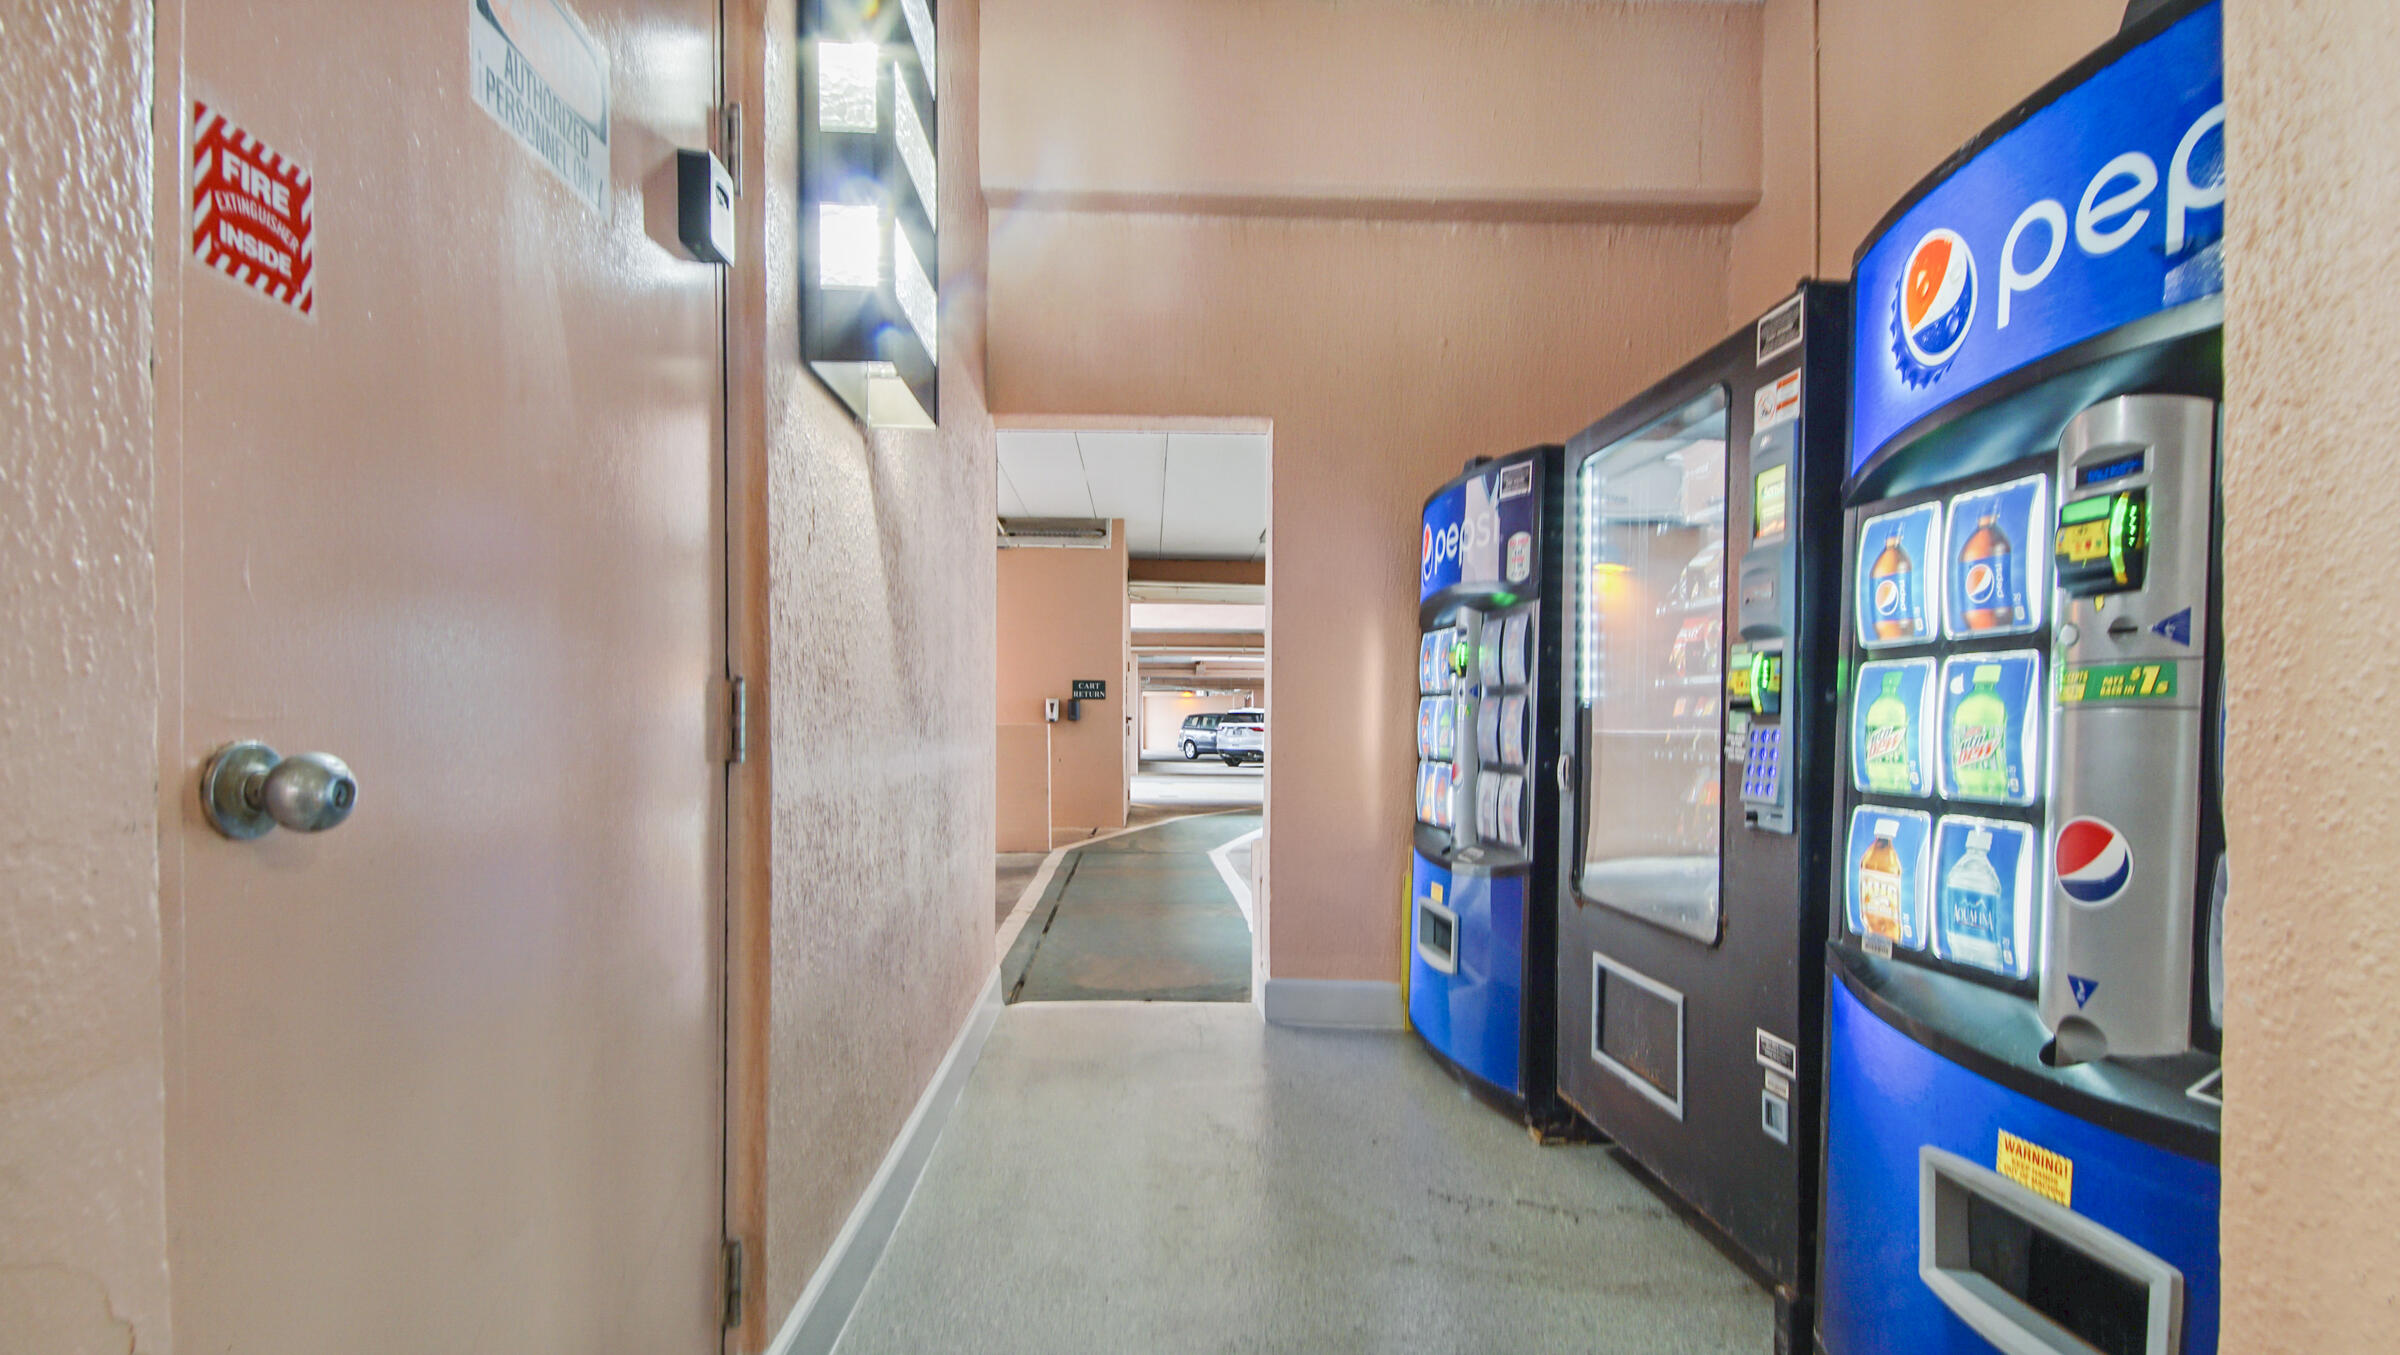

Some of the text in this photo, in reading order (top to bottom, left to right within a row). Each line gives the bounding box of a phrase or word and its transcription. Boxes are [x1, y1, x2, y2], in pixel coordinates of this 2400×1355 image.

[486, 65, 570, 178] PERSONNEL
[504, 46, 589, 159] AUTHORIZED
[221, 146, 291, 220] FIRE
[214, 190, 300, 256] EXTINGUISHER
[219, 218, 292, 278] INSIDE
[1434, 504, 1500, 576] pepsi
[1073, 690, 1105, 698] RETURN
[1078, 682, 1100, 690] CART
[2004, 1135, 2069, 1178] WARNING!
